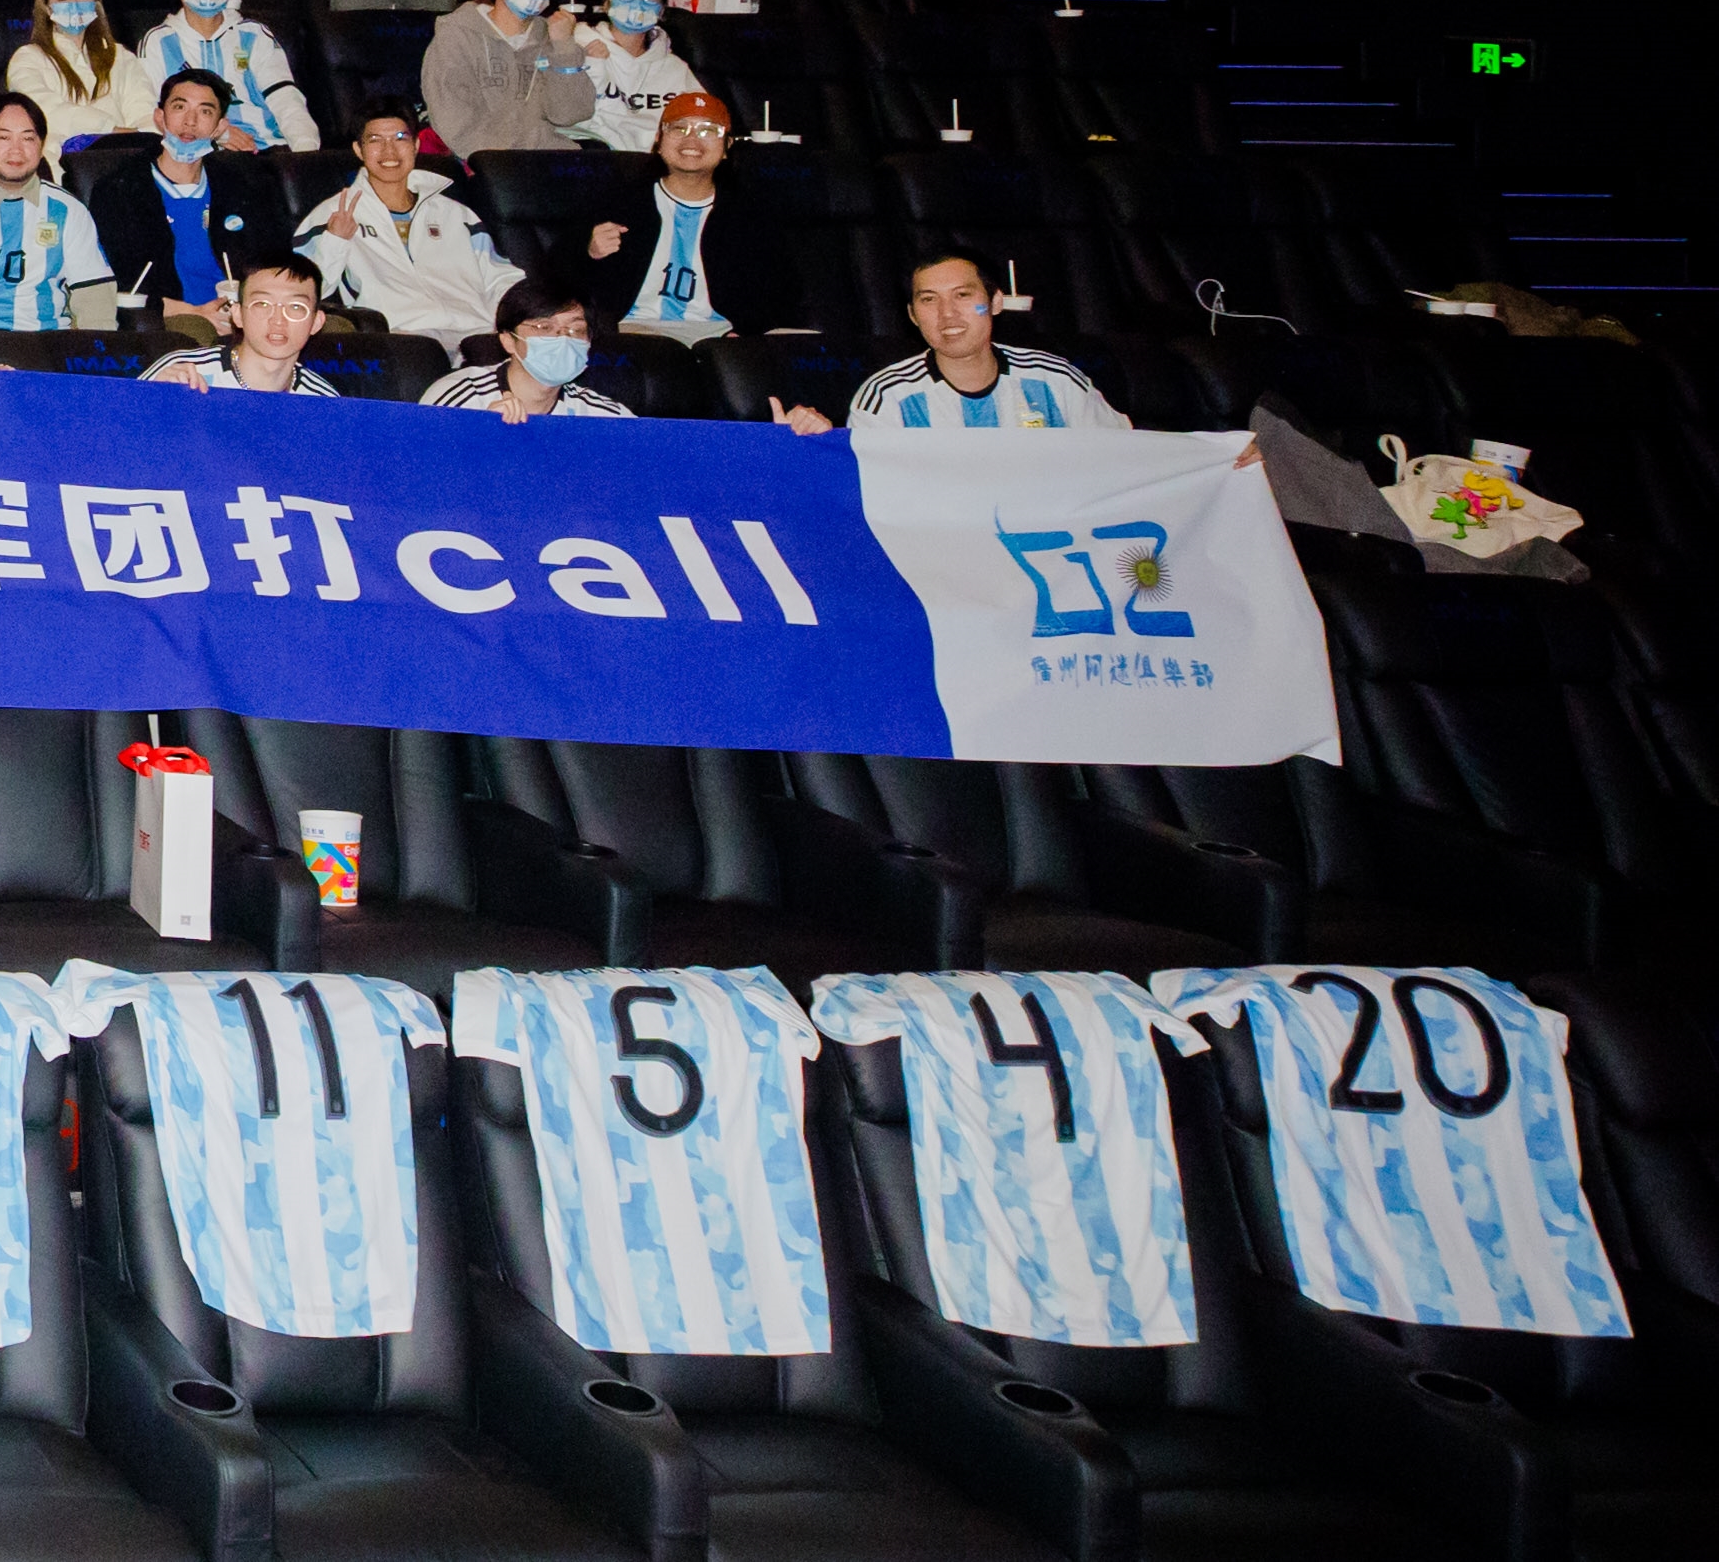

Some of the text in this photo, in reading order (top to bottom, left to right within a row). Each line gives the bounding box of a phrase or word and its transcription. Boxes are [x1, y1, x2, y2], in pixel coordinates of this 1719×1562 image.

[660, 262, 695, 303] 10
[65, 356, 144, 374] IMAX
[217, 978, 348, 1121] 11
[610, 985, 704, 1139] 5
[971, 991, 1077, 1144] 4
[1289, 971, 1512, 1120] 20
